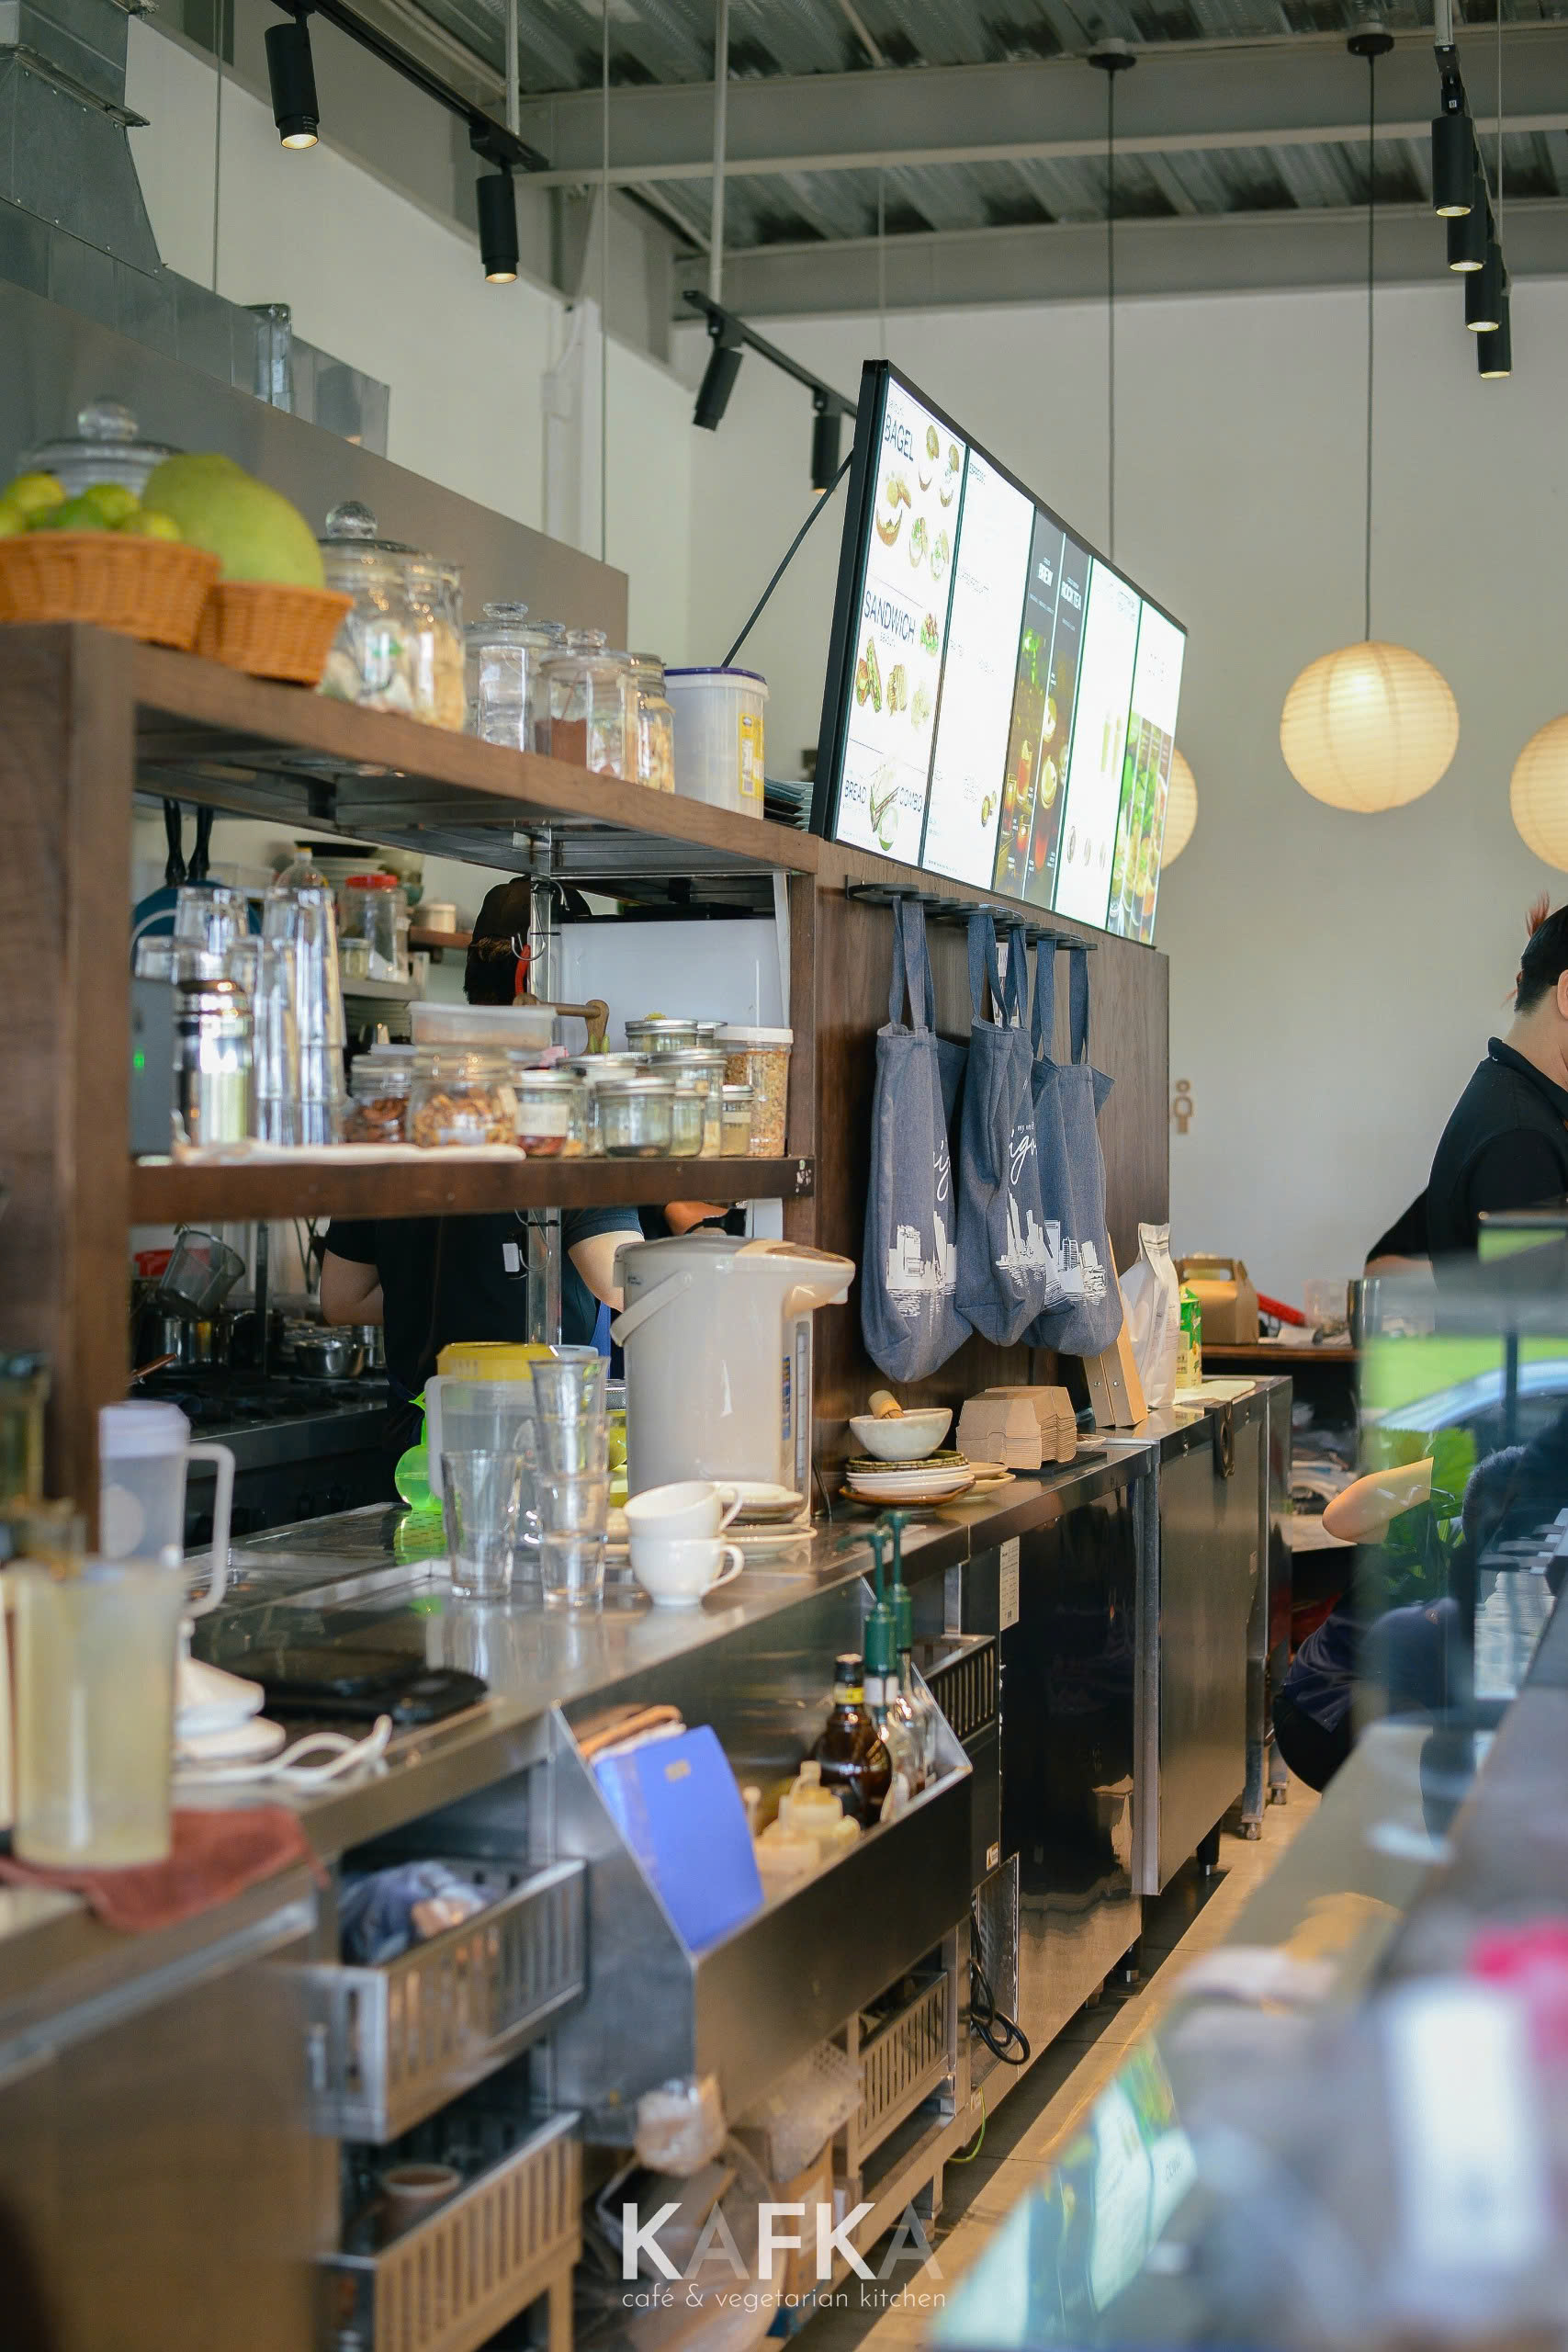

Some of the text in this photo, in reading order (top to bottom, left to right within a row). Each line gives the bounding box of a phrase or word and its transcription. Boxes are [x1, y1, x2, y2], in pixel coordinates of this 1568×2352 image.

[885, 413, 914, 462] BAGEL
[863, 590, 916, 644] SANDWICH
[845, 779, 923, 812] BREAD COMBO
